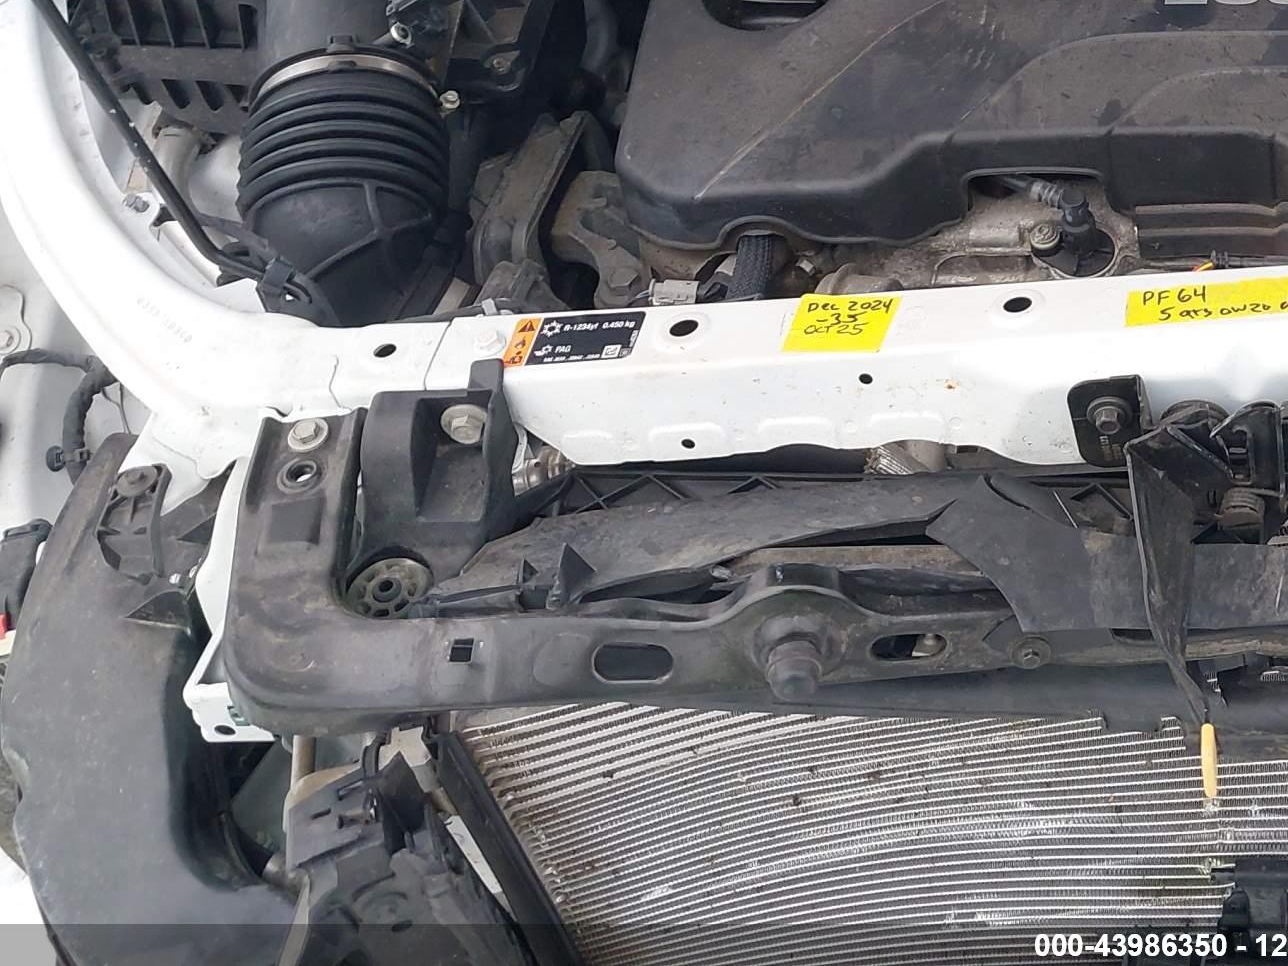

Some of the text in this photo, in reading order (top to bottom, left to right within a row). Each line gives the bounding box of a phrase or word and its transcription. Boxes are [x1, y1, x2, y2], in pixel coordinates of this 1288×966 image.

[1177, 285, 1207, 303] 64
[847, 298, 894, 314] 2024
[602, 321, 623, 329] 0.450
[624, 320, 636, 328] kg
[835, 322, 870, 335] 25
[554, 345, 572, 354] PAG
